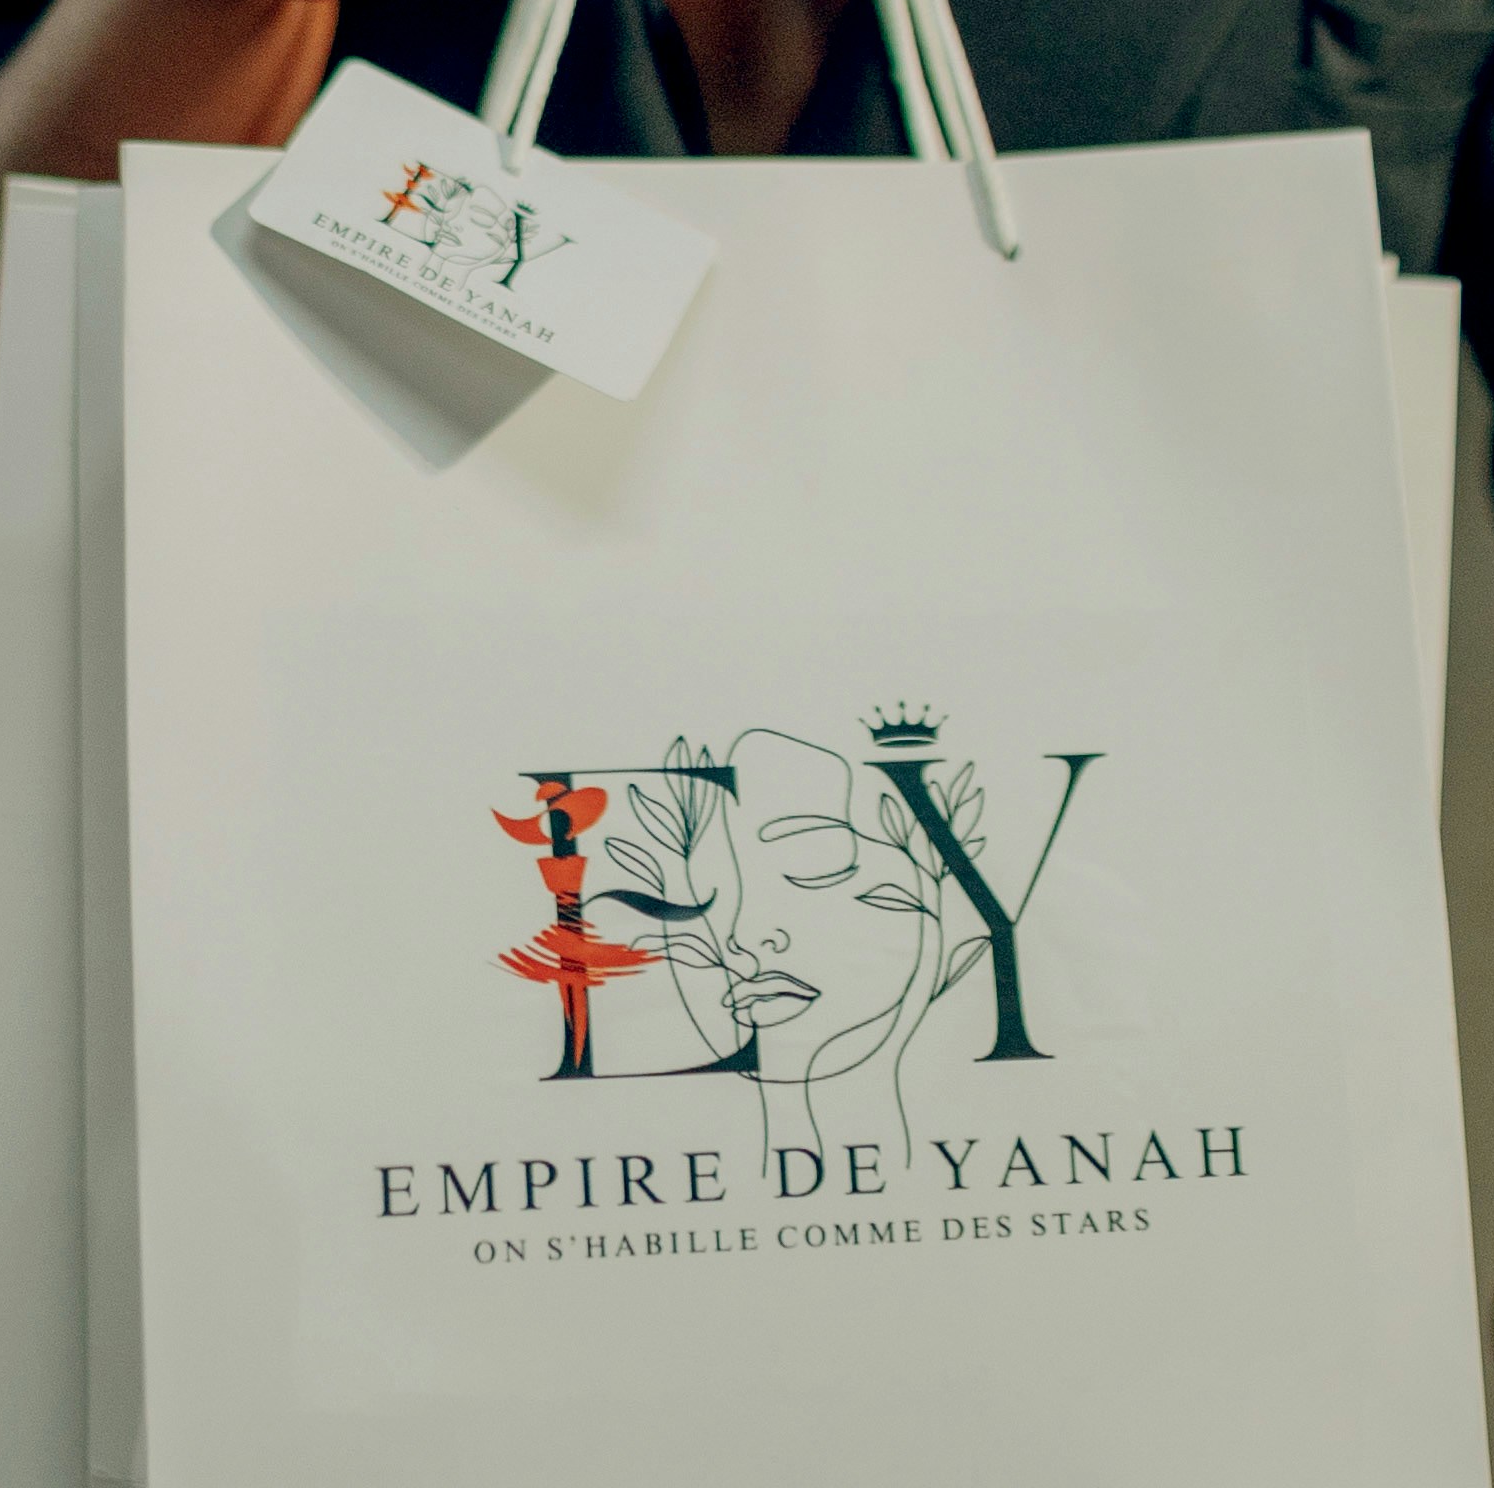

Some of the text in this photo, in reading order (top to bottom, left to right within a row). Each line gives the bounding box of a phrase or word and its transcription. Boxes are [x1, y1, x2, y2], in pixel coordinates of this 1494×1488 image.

[313, 213, 555, 343] EMPIRE DE YANAH
[375, 1126, 1248, 1219] EMPIRE DE YANAH
[473, 1207, 1152, 1265] ON S'HABILLE COMME DES STARS
